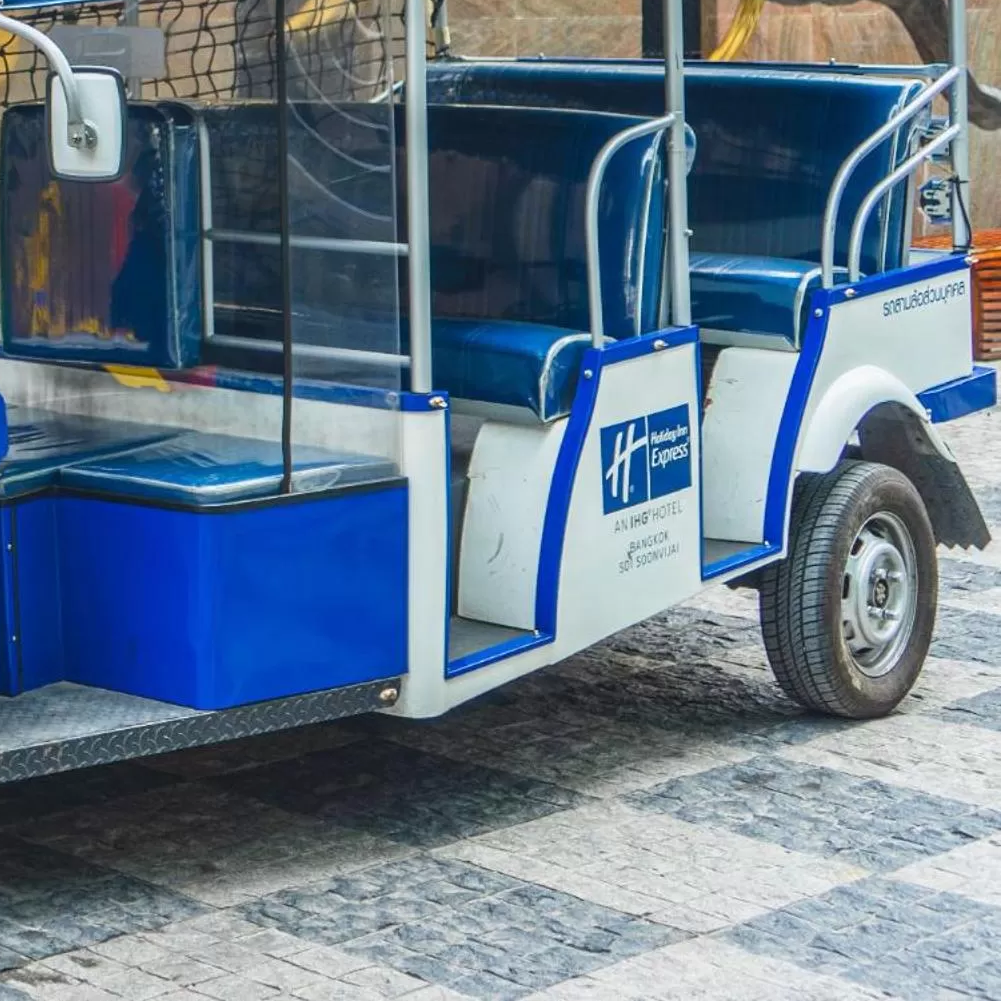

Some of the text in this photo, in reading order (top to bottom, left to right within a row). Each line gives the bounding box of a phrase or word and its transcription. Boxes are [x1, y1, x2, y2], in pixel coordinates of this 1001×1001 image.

[651, 442, 689, 469] Express
[614, 518, 628, 534] AN
[652, 500, 684, 521] HOTEL
[629, 529, 669, 553] BANGKOK
[636, 542, 680, 568] SOONVIJAI
